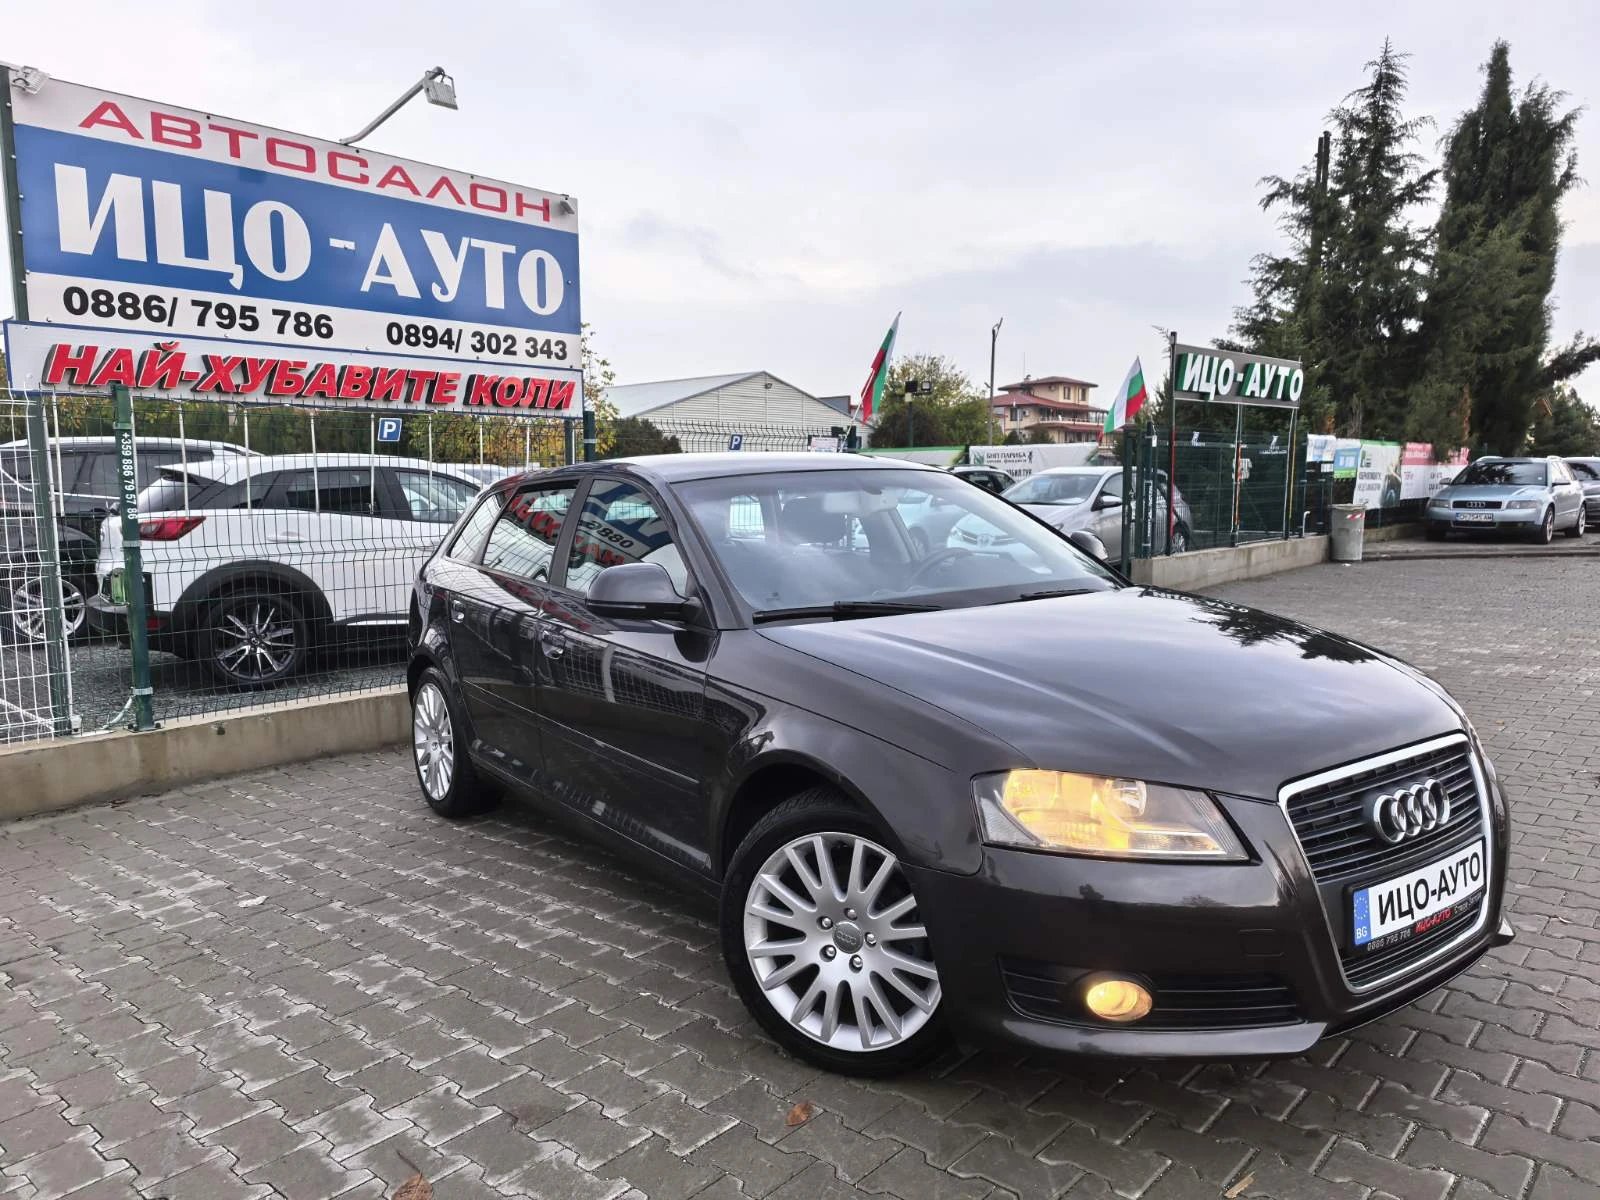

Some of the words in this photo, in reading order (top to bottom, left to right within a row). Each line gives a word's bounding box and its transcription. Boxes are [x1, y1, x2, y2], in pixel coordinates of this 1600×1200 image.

[78, 100, 550, 223] АВТОСАЛОН
[63, 286, 178, 328] 0886/
[191, 299, 259, 334] 795
[272, 308, 334, 340] 786
[386, 321, 463, 354] 0894/
[470, 329, 518, 358] 302
[525, 335, 569, 362] 343
[43, 340, 460, 406] НАЙ-ХУБАВИТЕ
[468, 373, 576, 411] КОЛИ
[1180, 352, 1304, 402] ИЦО-АУТО
[123, 479, 135, 491] 79
[125, 493, 136, 505] 57
[1378, 851, 1481, 926] ИЦО-АУТО
[1356, 926, 1368, 939] BG
